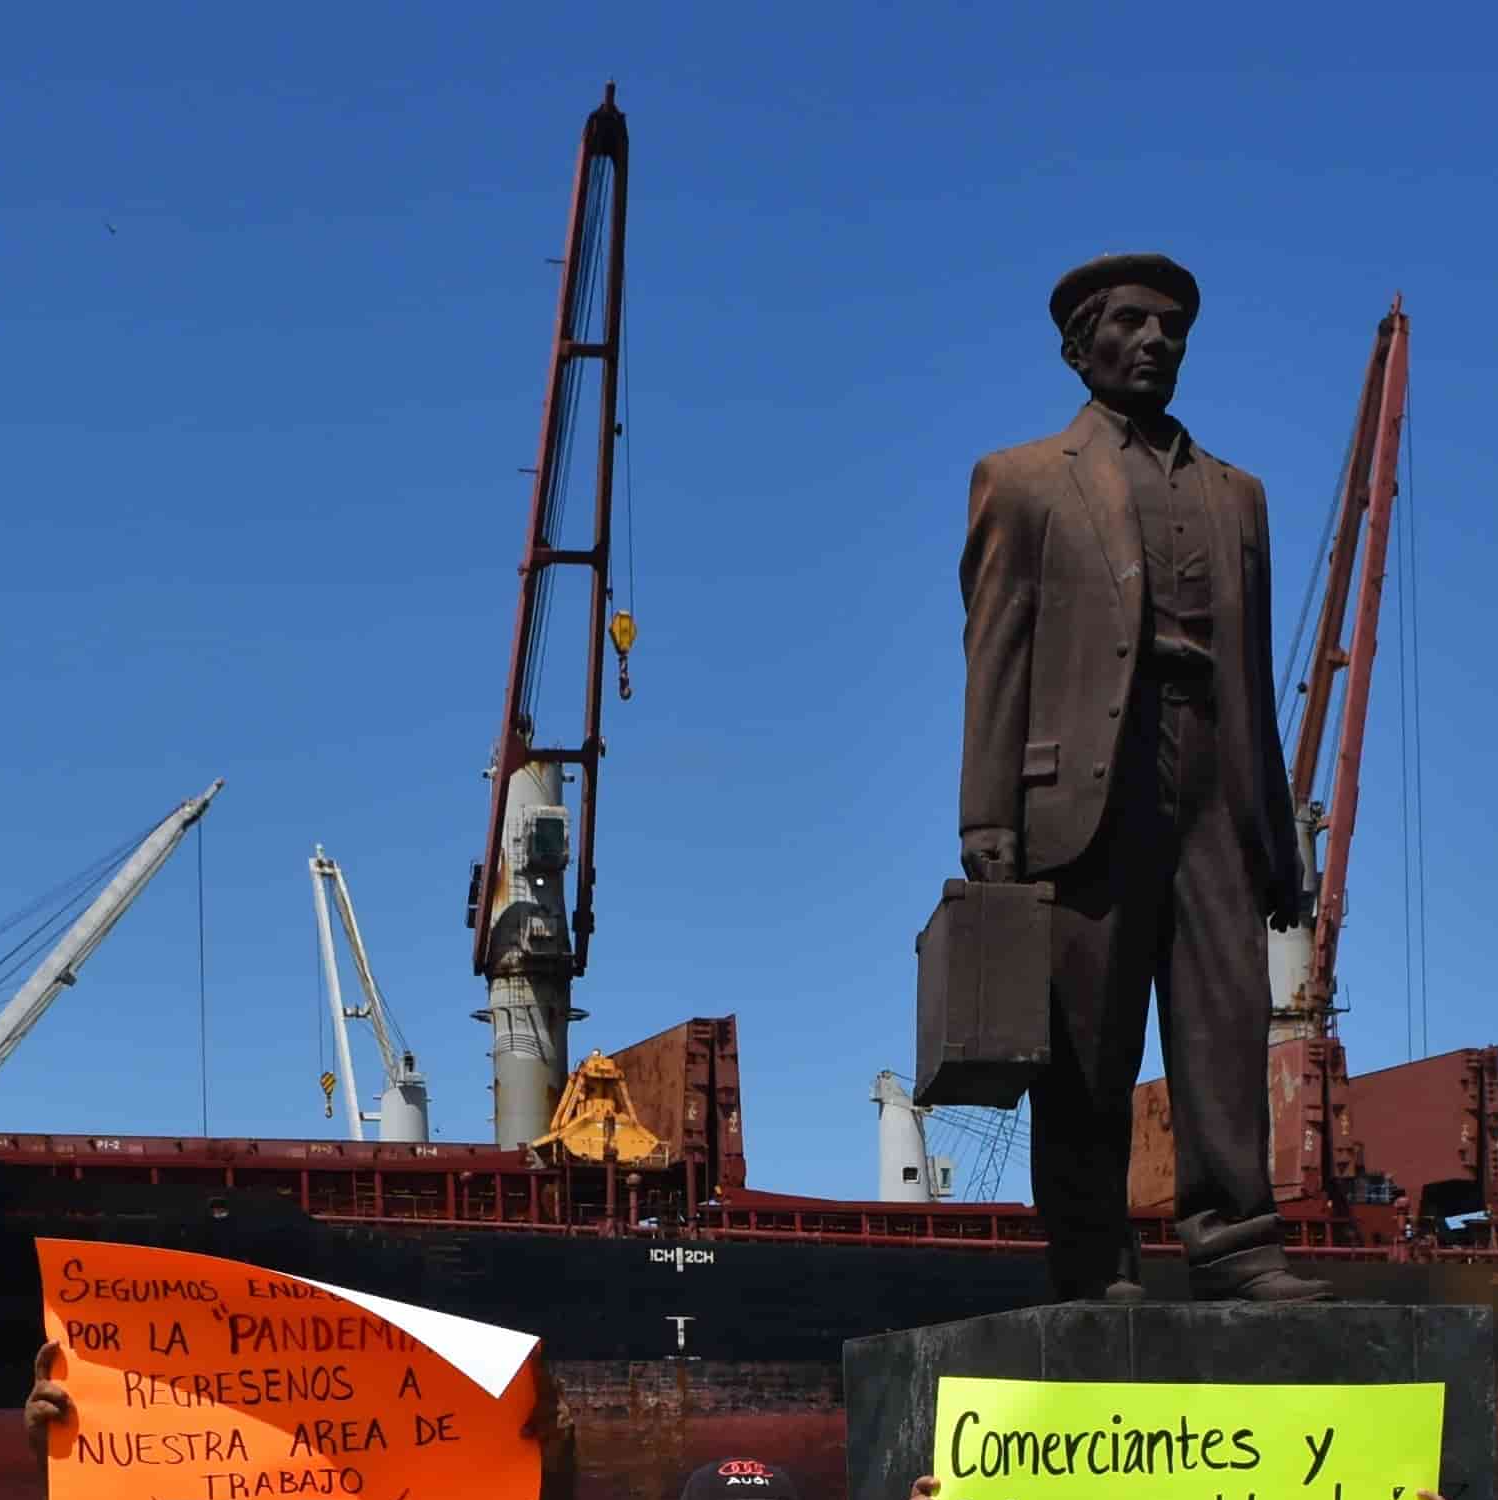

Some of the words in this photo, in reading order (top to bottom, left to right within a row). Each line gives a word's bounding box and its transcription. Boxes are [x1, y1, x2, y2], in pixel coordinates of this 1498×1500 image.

[60, 1260, 218, 1303] SEGUIMOS
[67, 1319, 120, 1354] POR
[150, 1321, 189, 1355] LA
[126, 1366, 354, 1408] REGRESENOS
[400, 1369, 421, 1400] A
[77, 1428, 249, 1467] NUESTRA
[291, 1419, 388, 1459] AREA
[414, 1414, 461, 1447] DE
[952, 1411, 1261, 1478] Comerciantes
[1303, 1427, 1335, 1485] y
[200, 1468, 364, 1500] TRABAJO
[726, 1477, 769, 1486] AUDI
